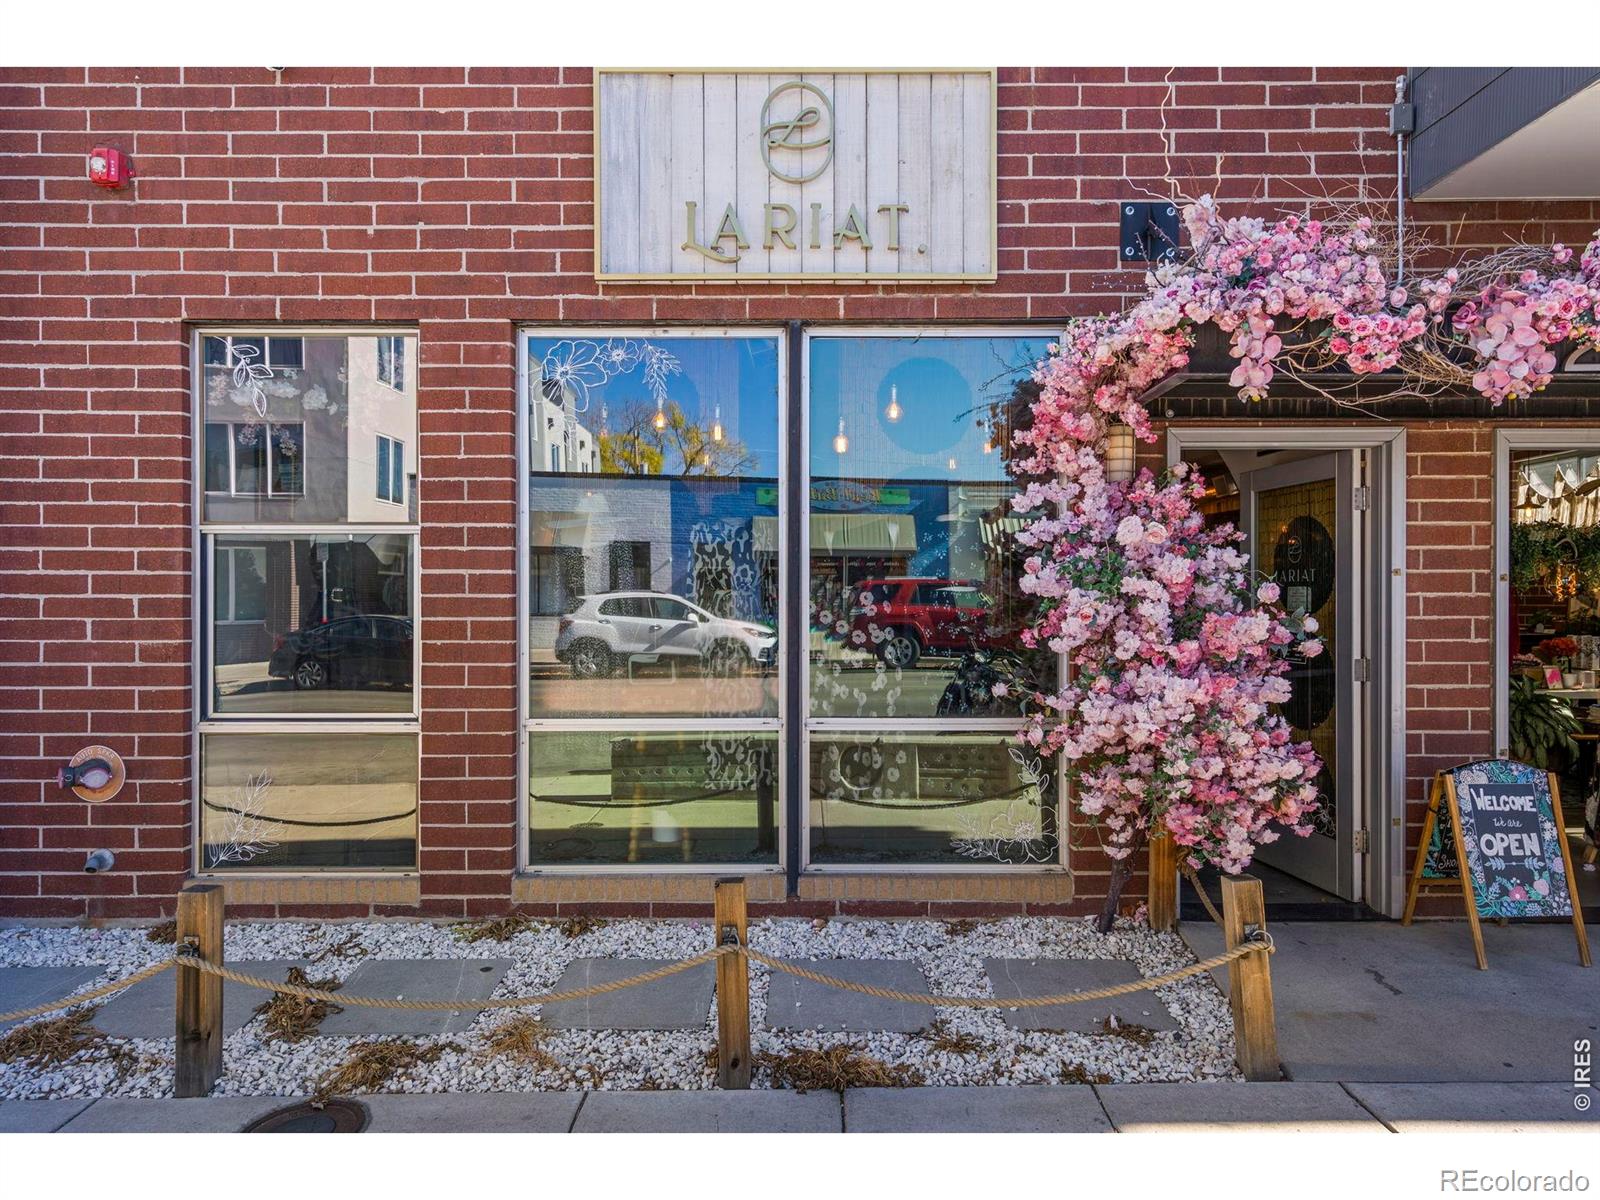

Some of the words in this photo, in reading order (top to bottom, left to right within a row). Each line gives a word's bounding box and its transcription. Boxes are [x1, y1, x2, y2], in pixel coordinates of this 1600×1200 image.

[1273, 568, 1316, 587] LARIAT
[75, 749, 93, 763] AUTO
[1507, 819, 1522, 828] are
[1479, 833, 1542, 857] OPEN
